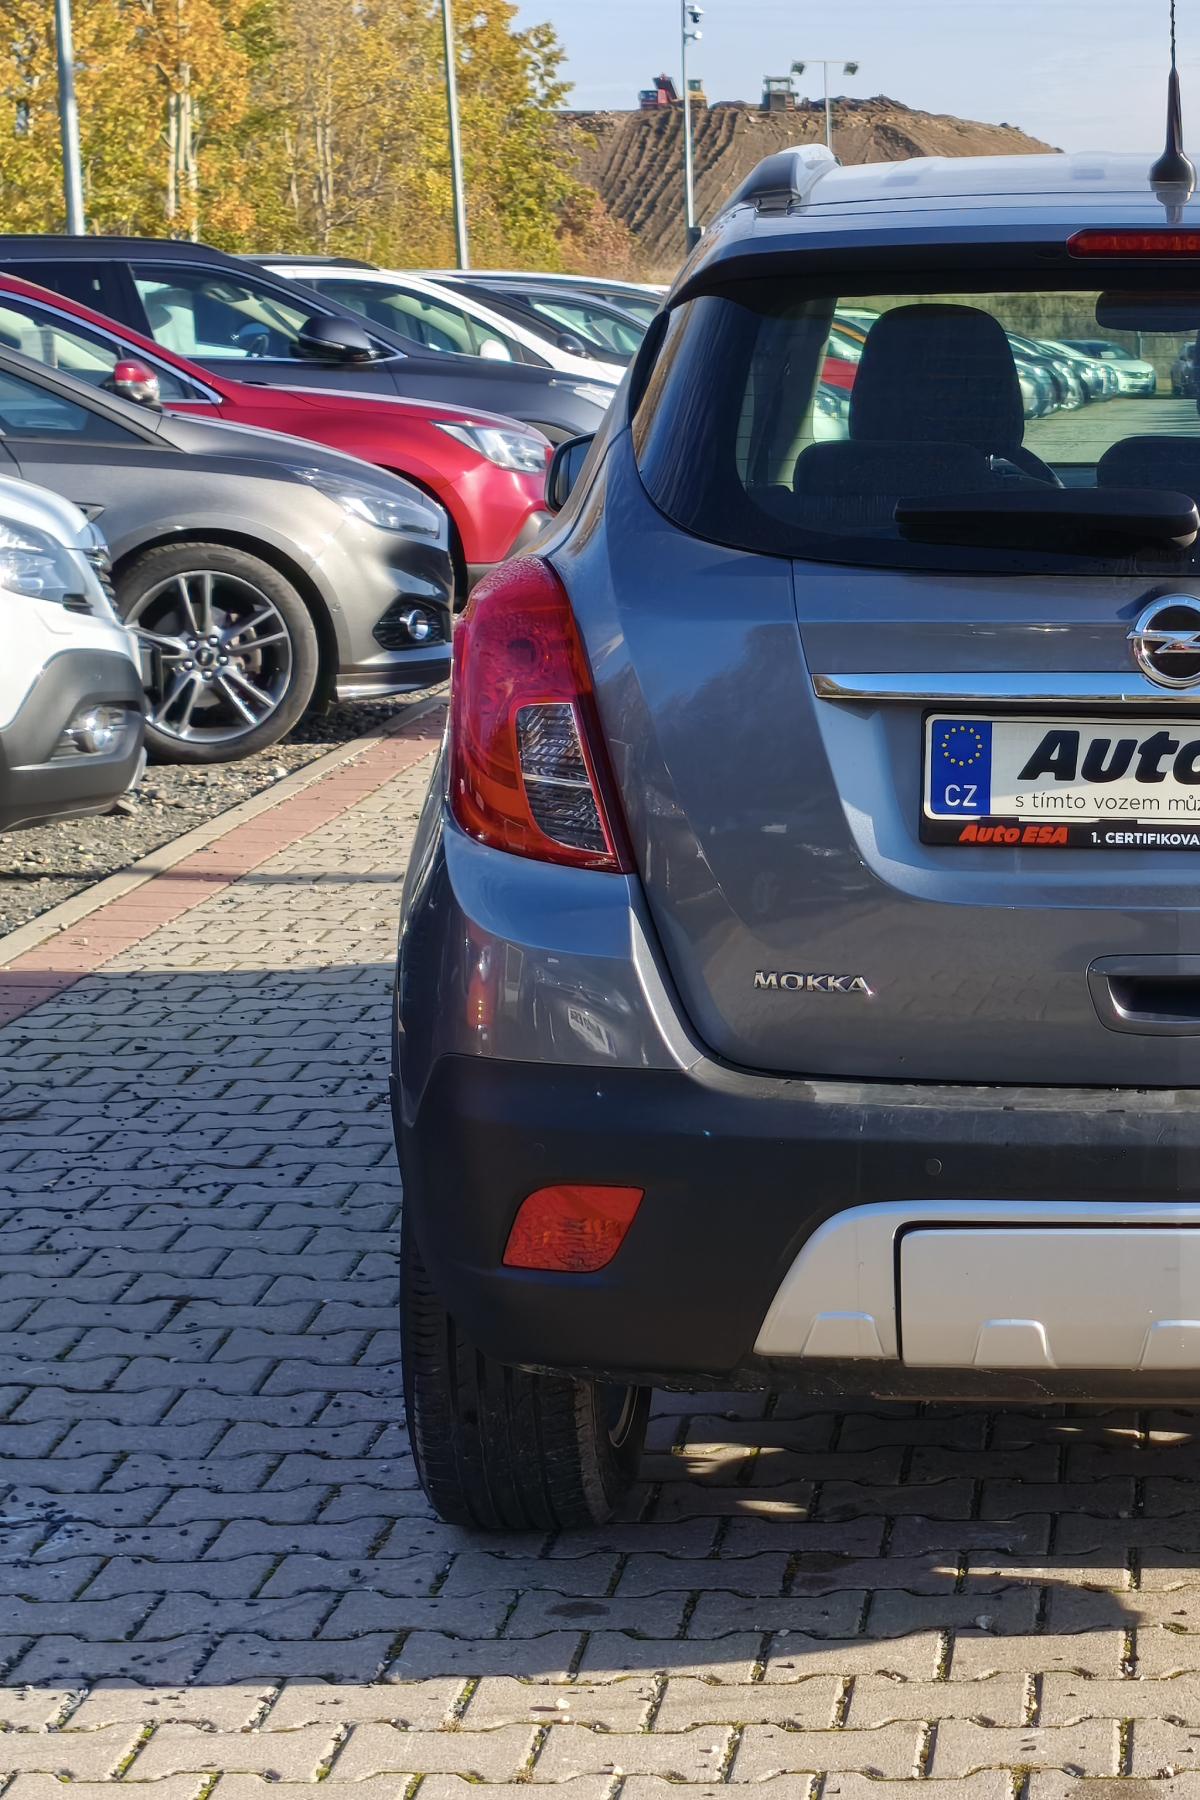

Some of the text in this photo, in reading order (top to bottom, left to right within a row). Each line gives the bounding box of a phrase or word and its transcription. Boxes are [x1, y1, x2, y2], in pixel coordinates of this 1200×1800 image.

[945, 784, 977, 806] CZ
[1015, 796, 1024, 807] s
[1032, 792, 1086, 809] tímto
[1093, 796, 1160, 810] vozem
[959, 825, 1069, 843] Auto ESA
[1091, 832, 1101, 843] 1.
[753, 971, 874, 996] MOKKA
